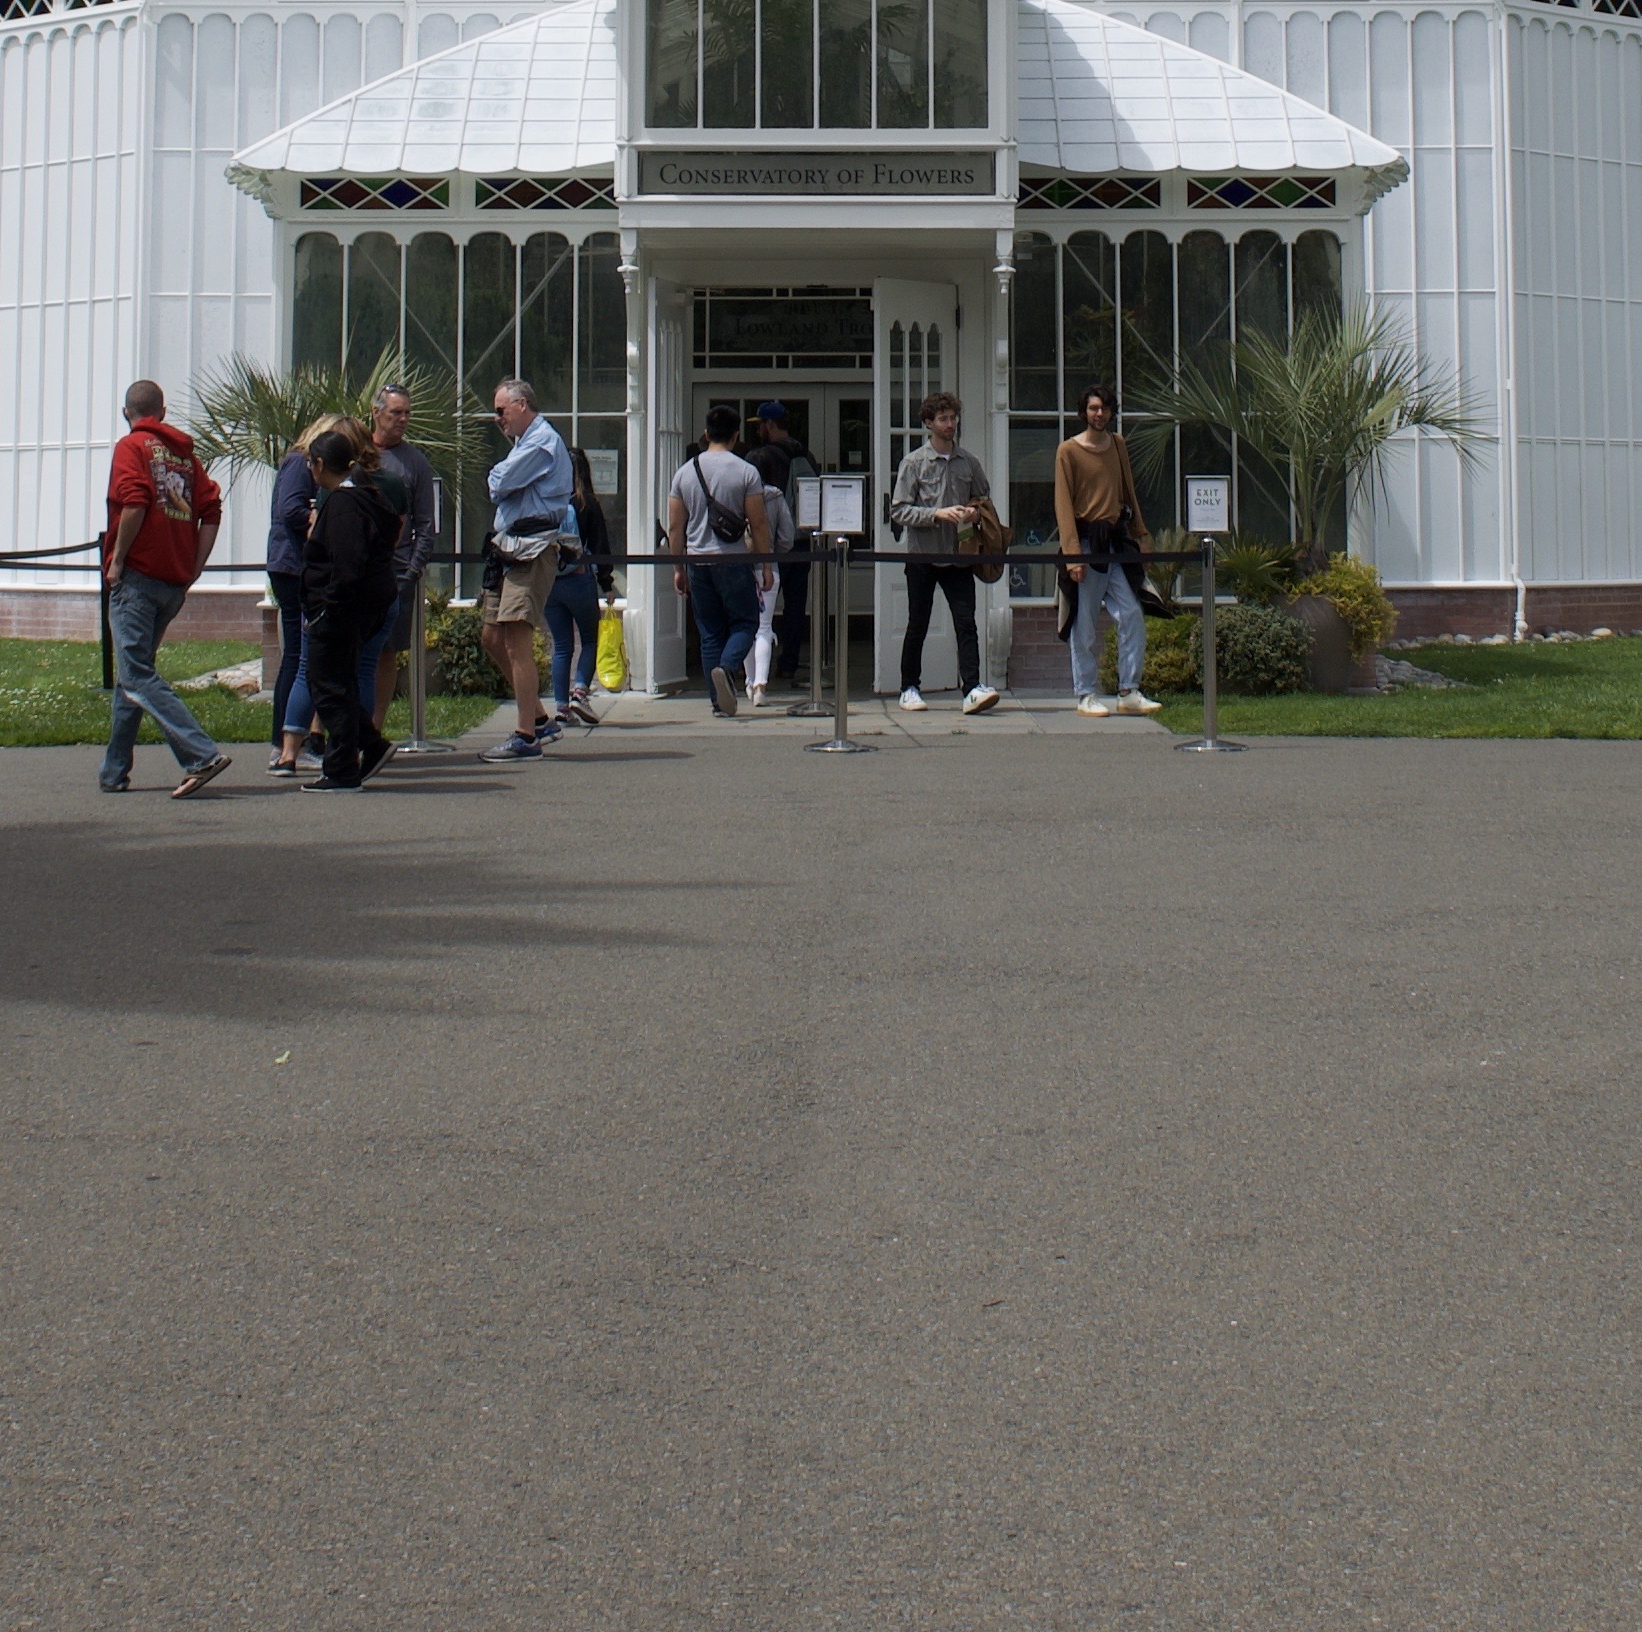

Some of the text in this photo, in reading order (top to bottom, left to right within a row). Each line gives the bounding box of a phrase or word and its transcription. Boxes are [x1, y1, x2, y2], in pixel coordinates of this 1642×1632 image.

[660, 163, 828, 185] CONSERVATORY
[873, 164, 975, 184] FLOWERS
[1196, 489, 1219, 497] EXIT
[1194, 498, 1221, 506] ONLY
